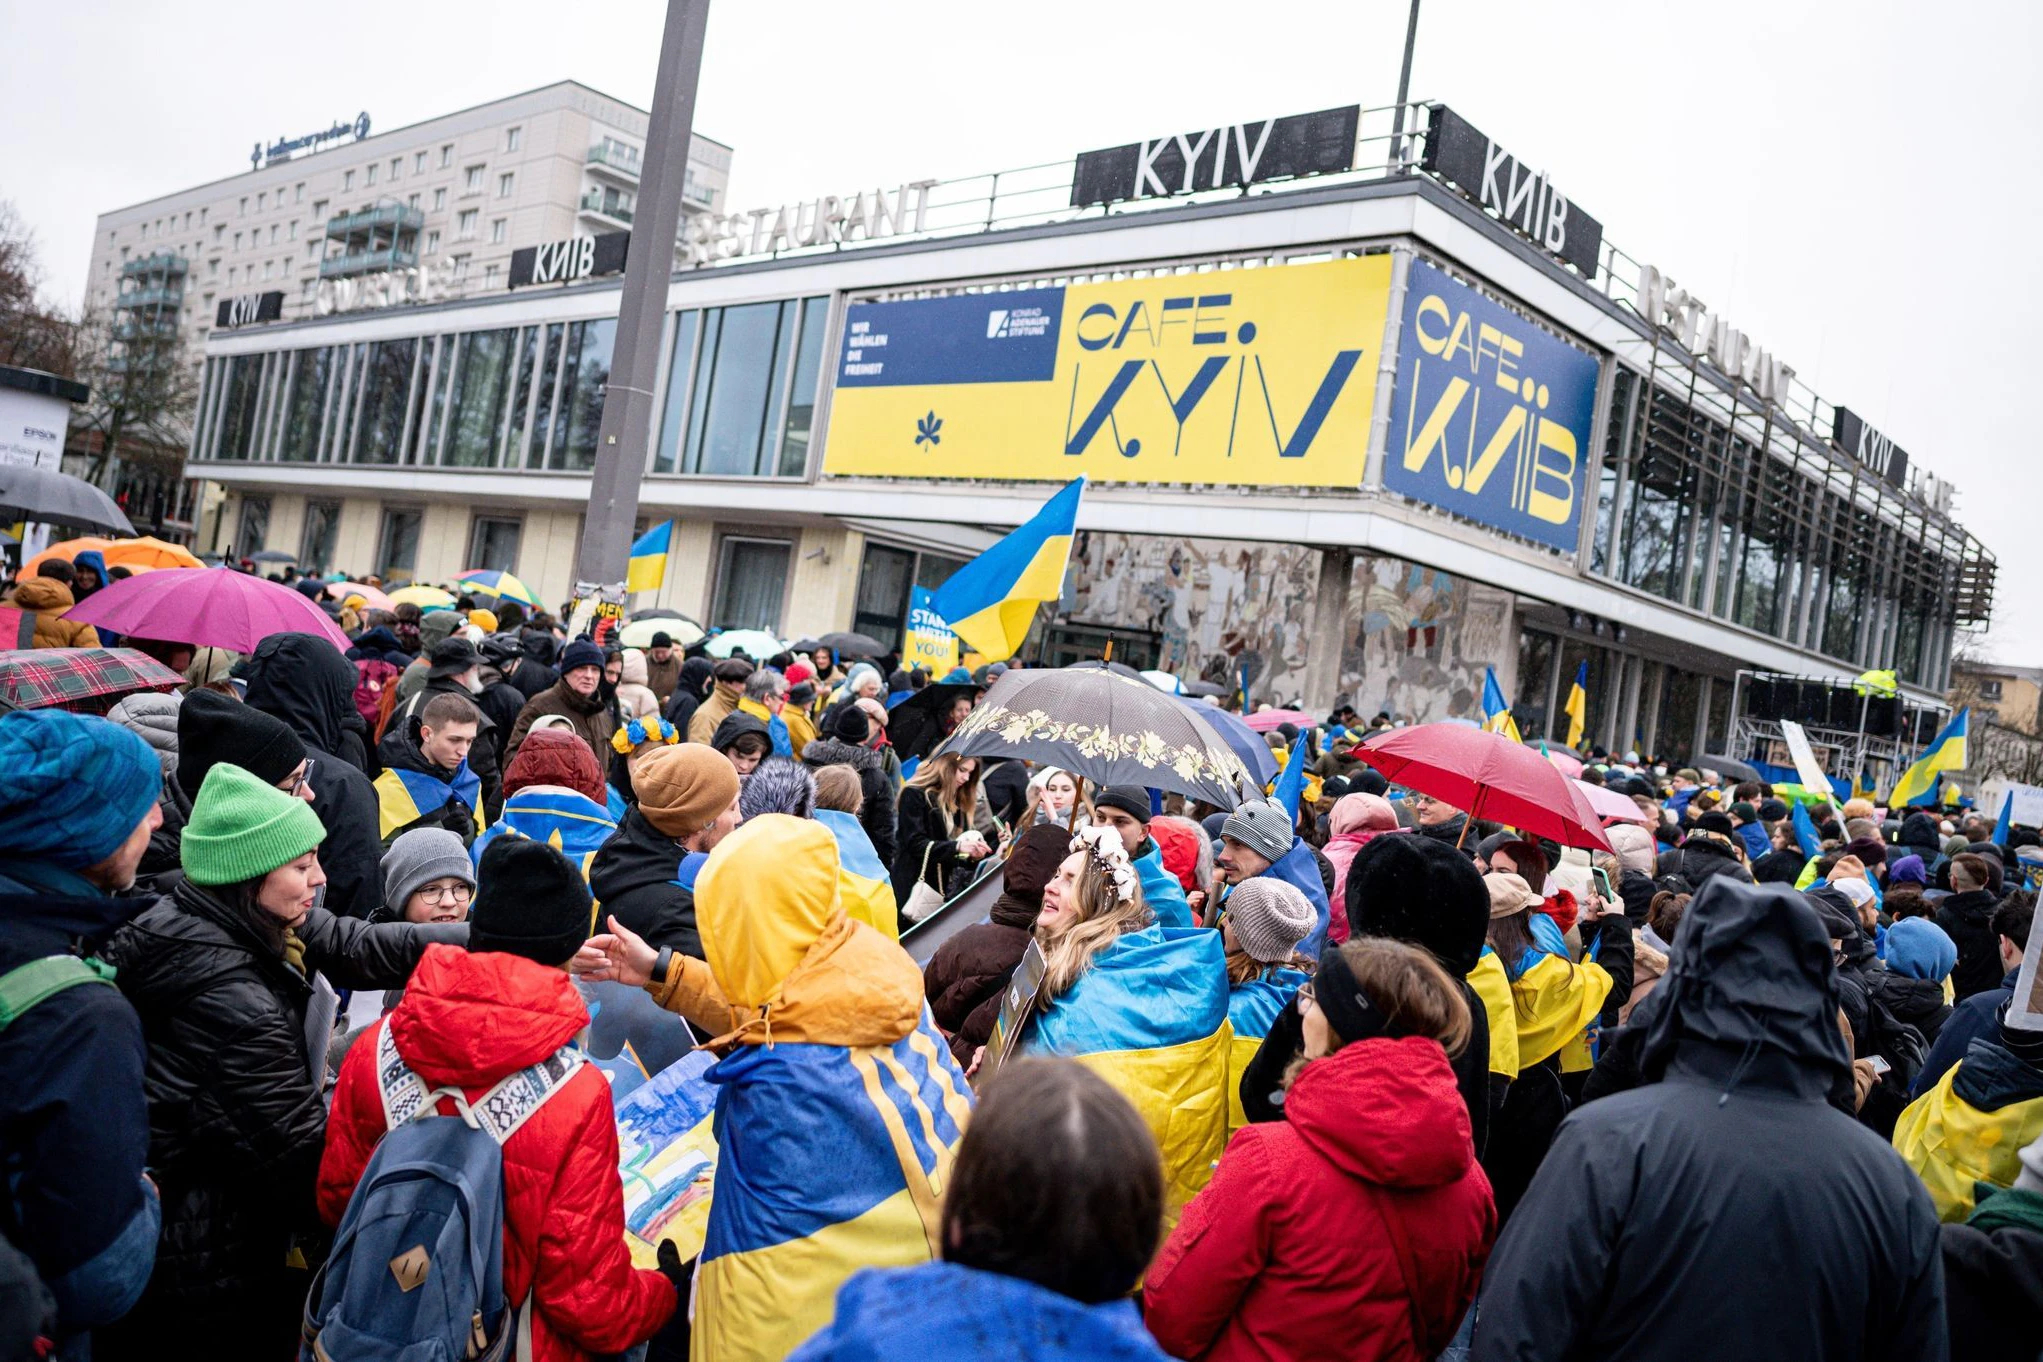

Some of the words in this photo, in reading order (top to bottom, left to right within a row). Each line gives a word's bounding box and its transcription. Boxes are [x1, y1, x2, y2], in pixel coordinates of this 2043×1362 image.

[1132, 119, 1276, 200] KYIV
[1077, 293, 1233, 351] CAFE
[1415, 294, 1524, 395] CAFE
[1065, 321, 1364, 458] KYIV
[23, 427, 57, 440] EPSON
[1857, 421, 1895, 477] KYIV
[911, 608, 951, 630] STAN
[916, 642, 949, 658] YOU!
